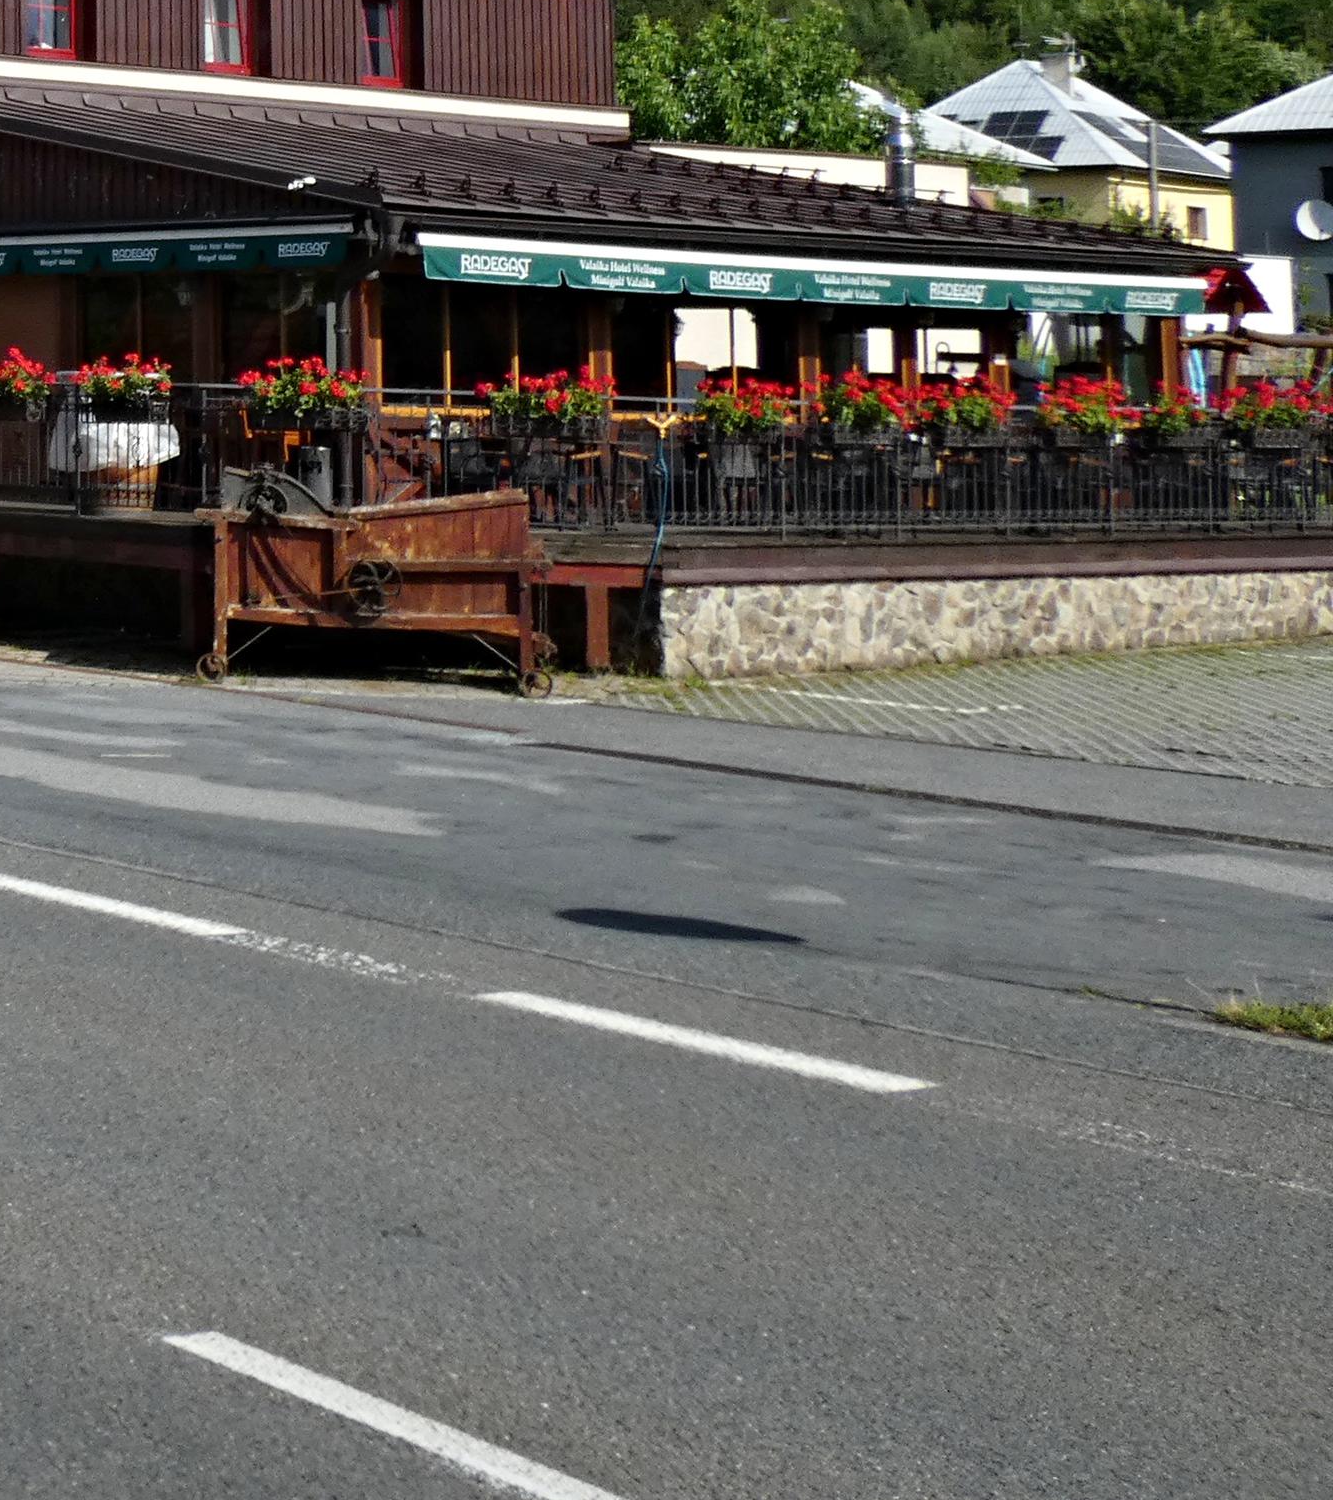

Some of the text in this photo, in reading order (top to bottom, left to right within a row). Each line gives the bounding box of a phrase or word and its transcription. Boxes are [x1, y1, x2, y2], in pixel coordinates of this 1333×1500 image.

[111, 247, 159, 263] RADEGAST
[278, 241, 331, 258] RADEGAST
[460, 254, 532, 280] RADEGAST
[709, 269, 773, 294] RADEGAST
[929, 282, 987, 304] RADEGAST
